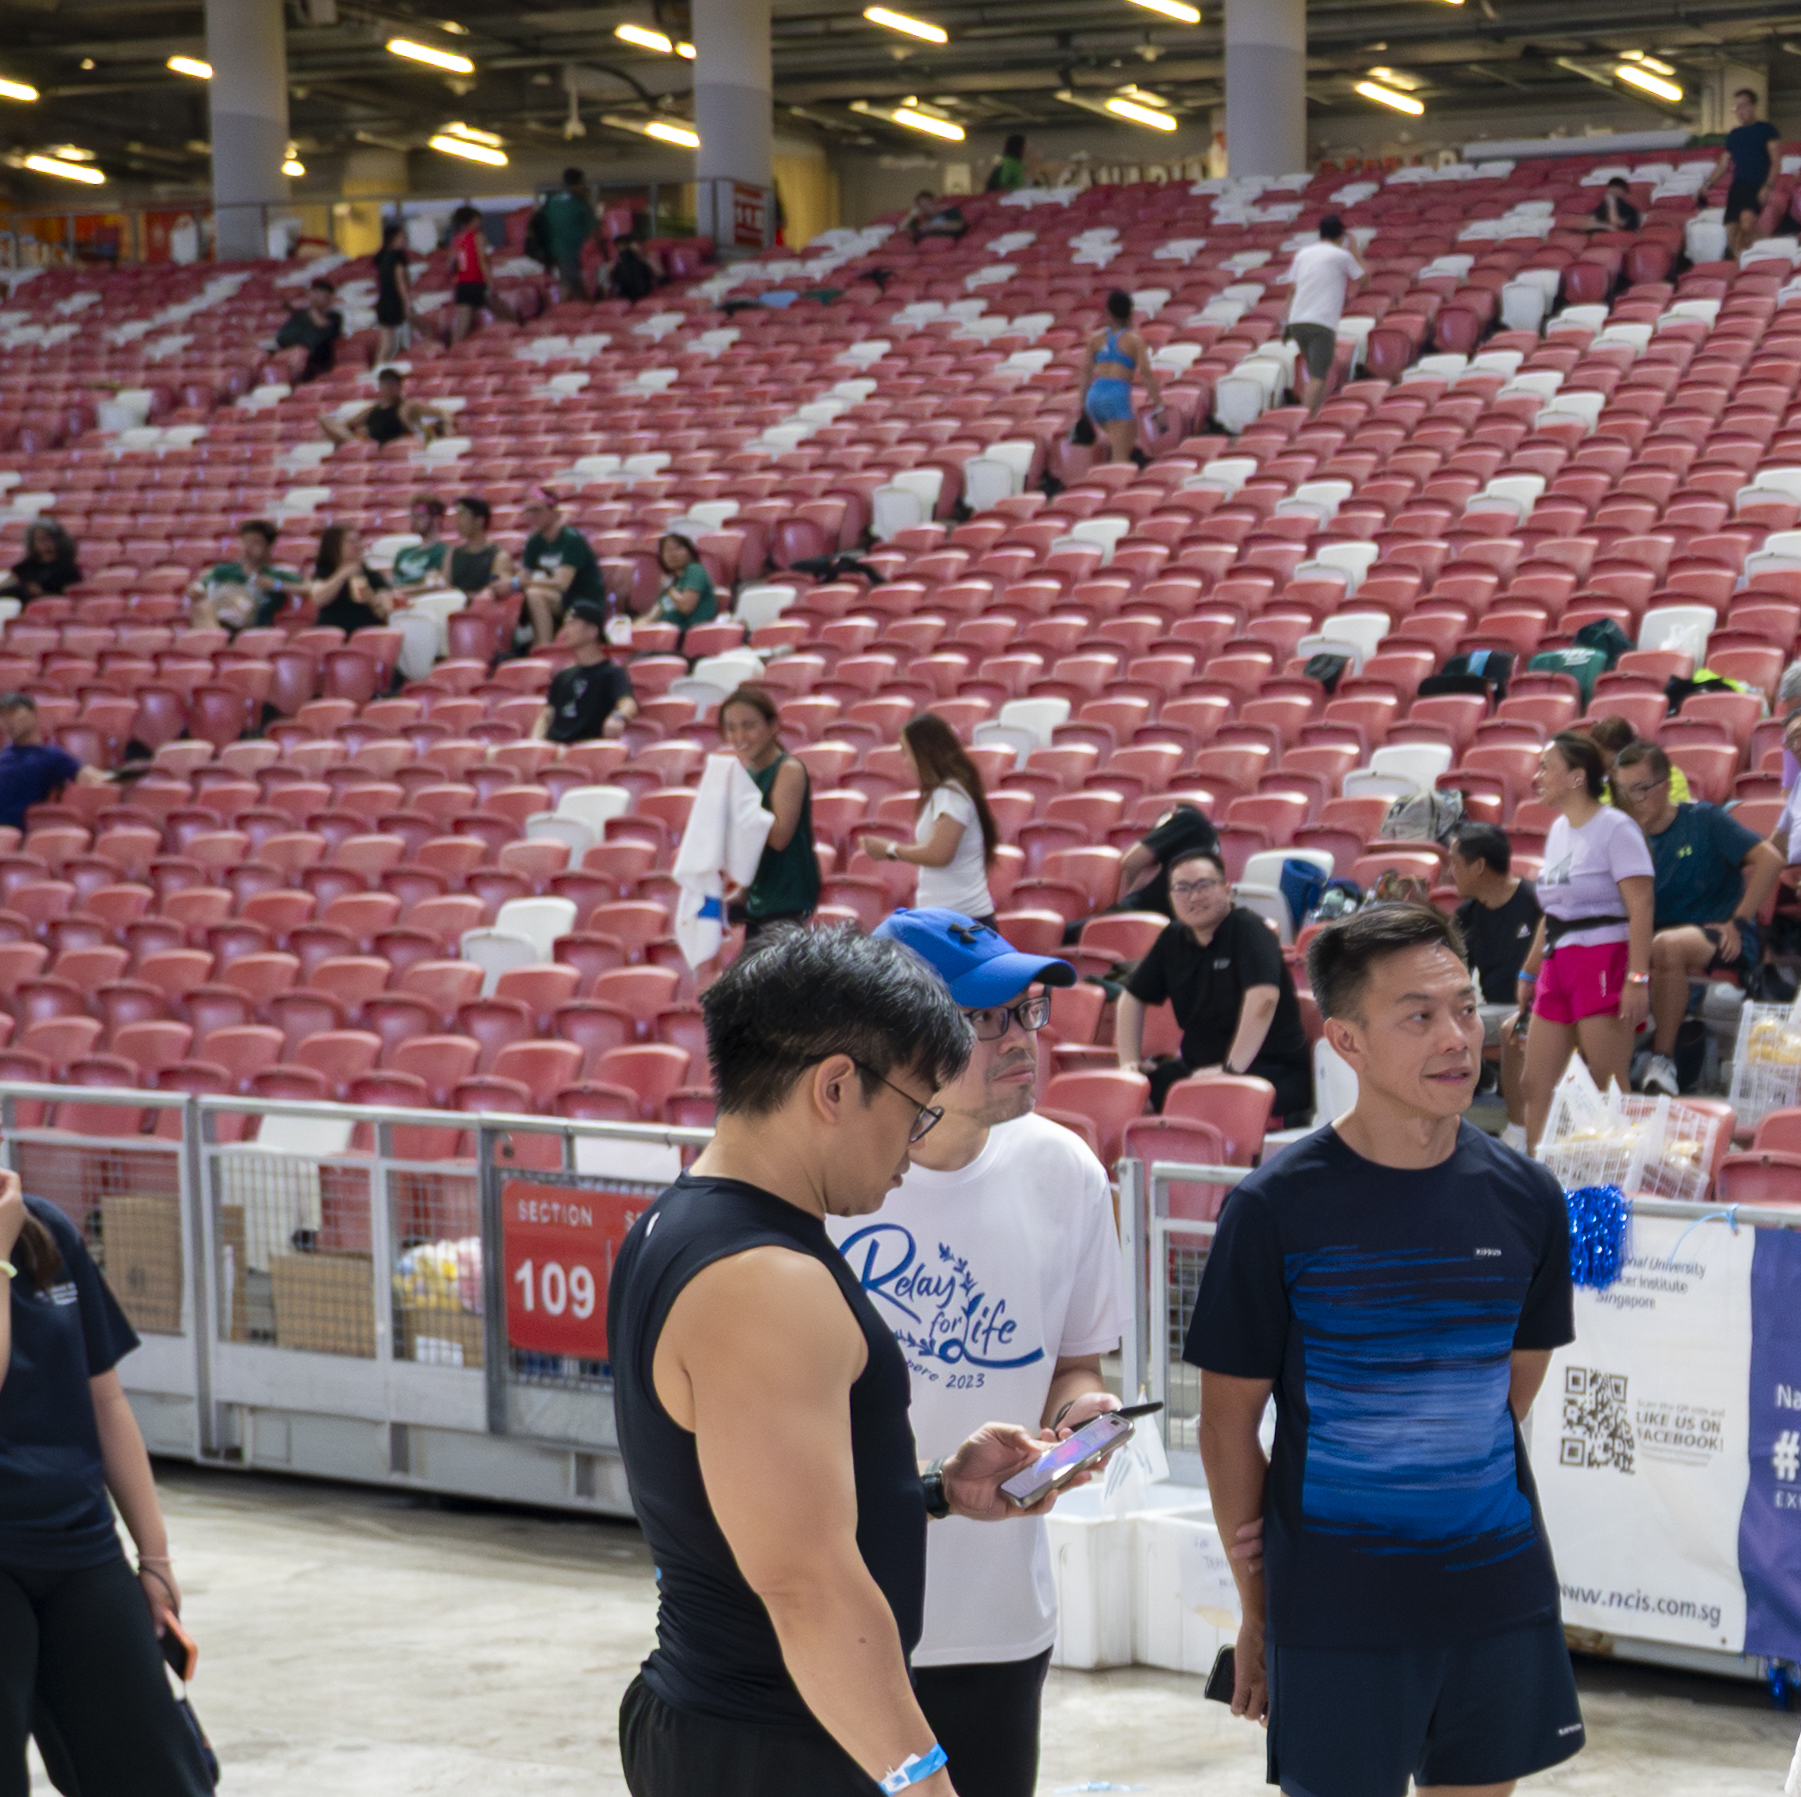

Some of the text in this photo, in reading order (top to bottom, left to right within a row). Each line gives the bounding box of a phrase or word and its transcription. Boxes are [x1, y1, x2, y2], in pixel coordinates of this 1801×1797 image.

[517, 1200, 593, 1227] SECTION
[838, 1223, 956, 1324] Relay
[1650, 1258, 1707, 1280] University
[515, 1259, 596, 1320] 109
[1639, 1275, 1688, 1294] Institute
[929, 1311, 963, 1338] for
[945, 1372, 986, 1390] 2023
[1636, 1411, 1721, 1434] LIKE US ON
